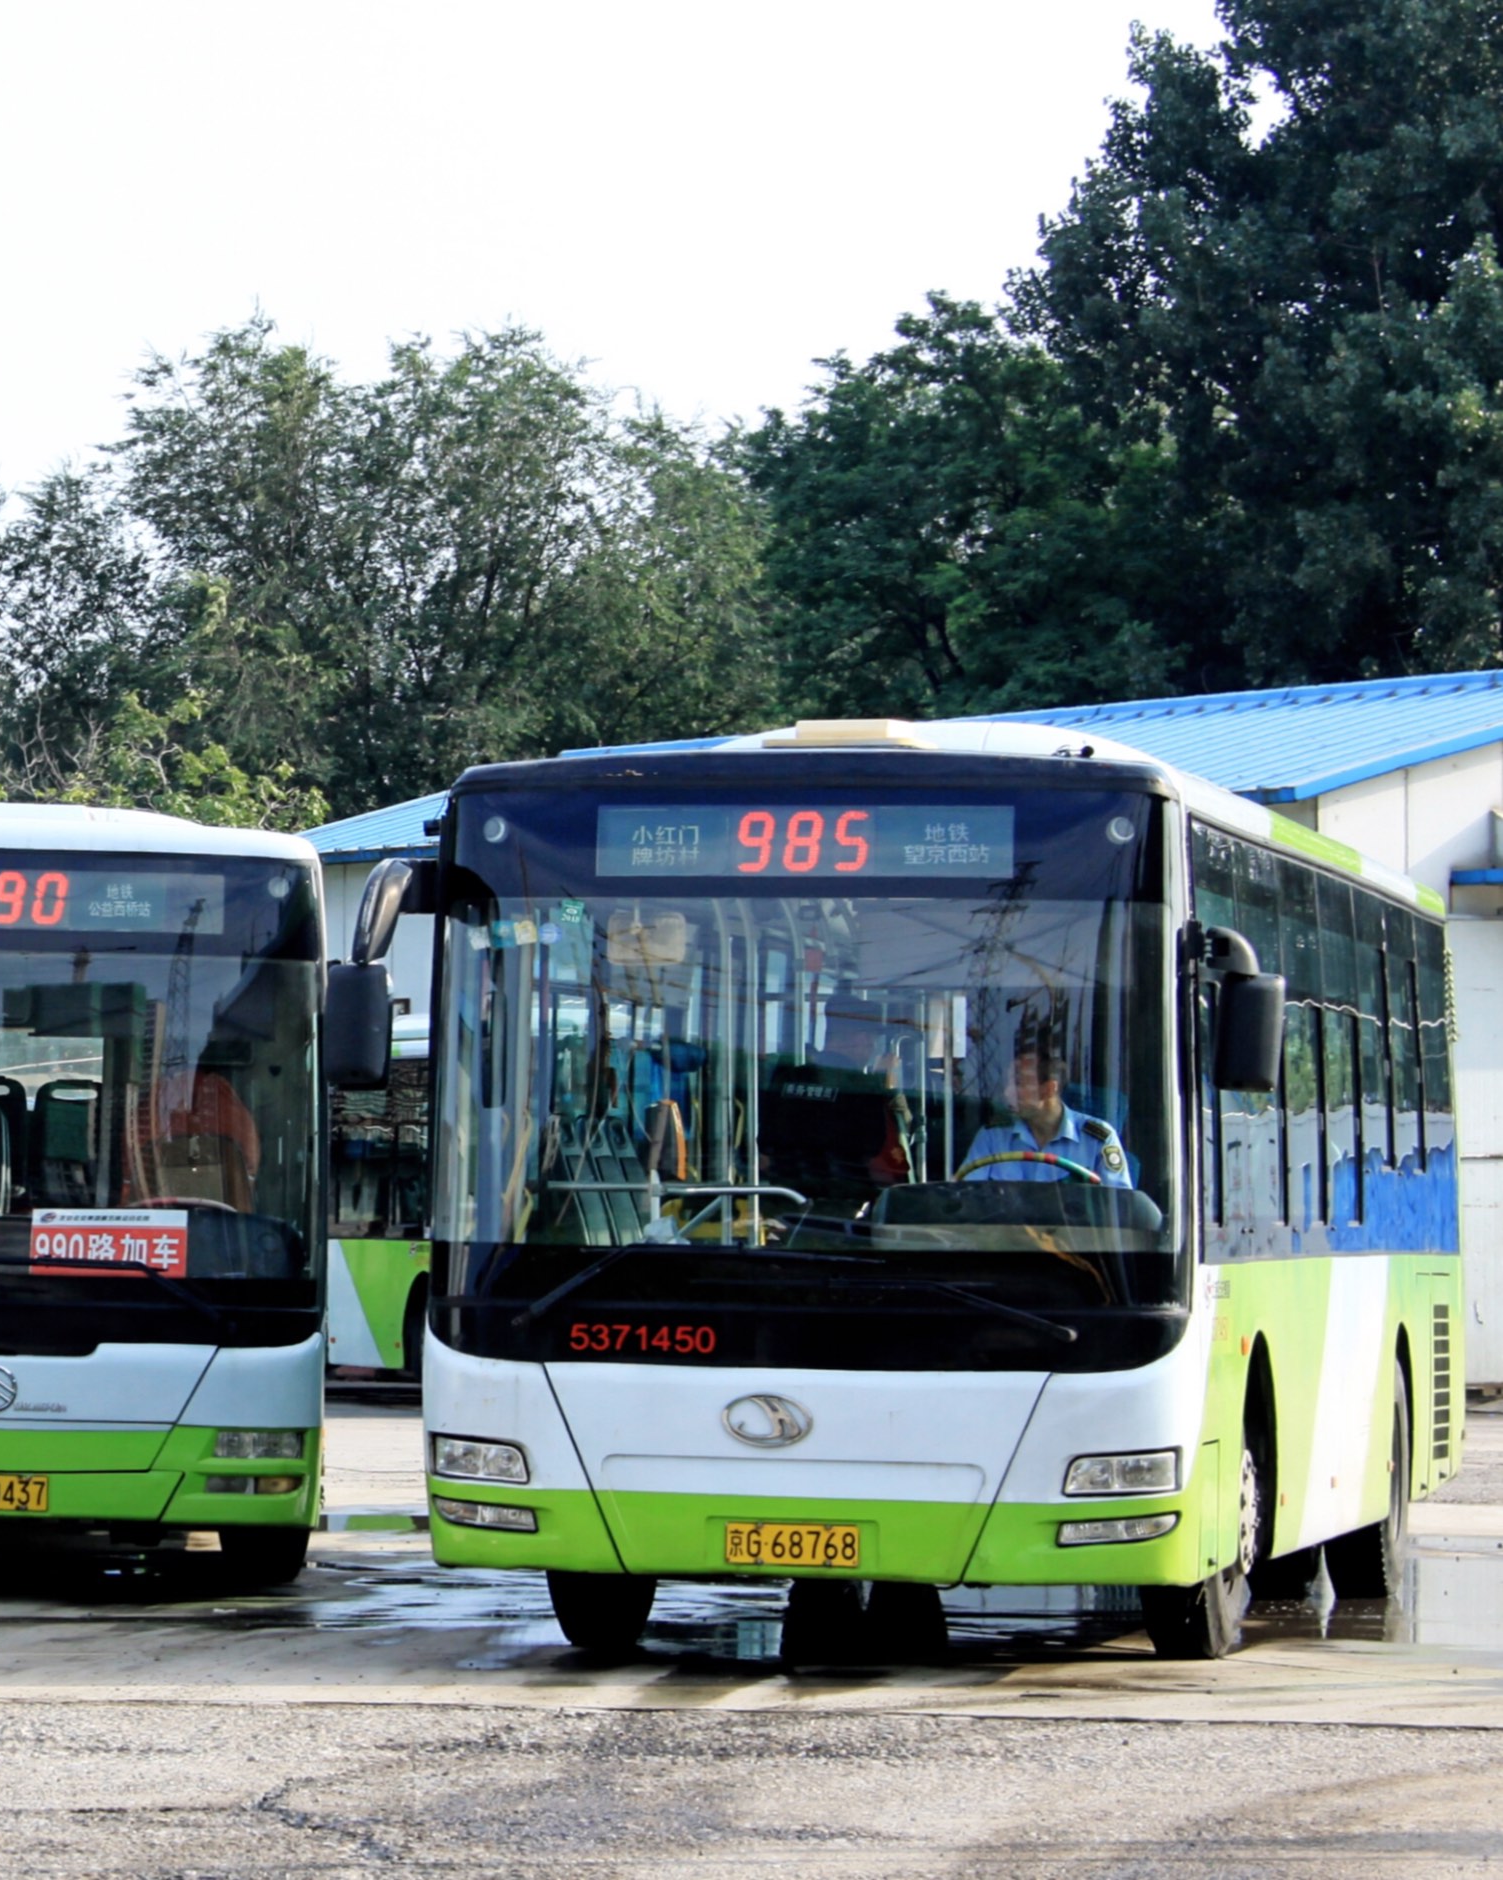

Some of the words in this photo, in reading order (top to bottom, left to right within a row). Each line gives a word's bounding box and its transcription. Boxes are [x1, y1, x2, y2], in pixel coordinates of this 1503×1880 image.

[632, 825, 699, 846] 小红门
[737, 810, 869, 873] 985
[923, 823, 970, 843] 地铁
[631, 845, 700, 867] 牌坊村
[903, 843, 990, 865] 望京西站
[106, 884, 134, 900] 地铁
[88, 901, 152, 918] 公益西桥站
[35, 1233, 180, 1270] 990路加车
[570, 1324, 716, 1353] 5371450
